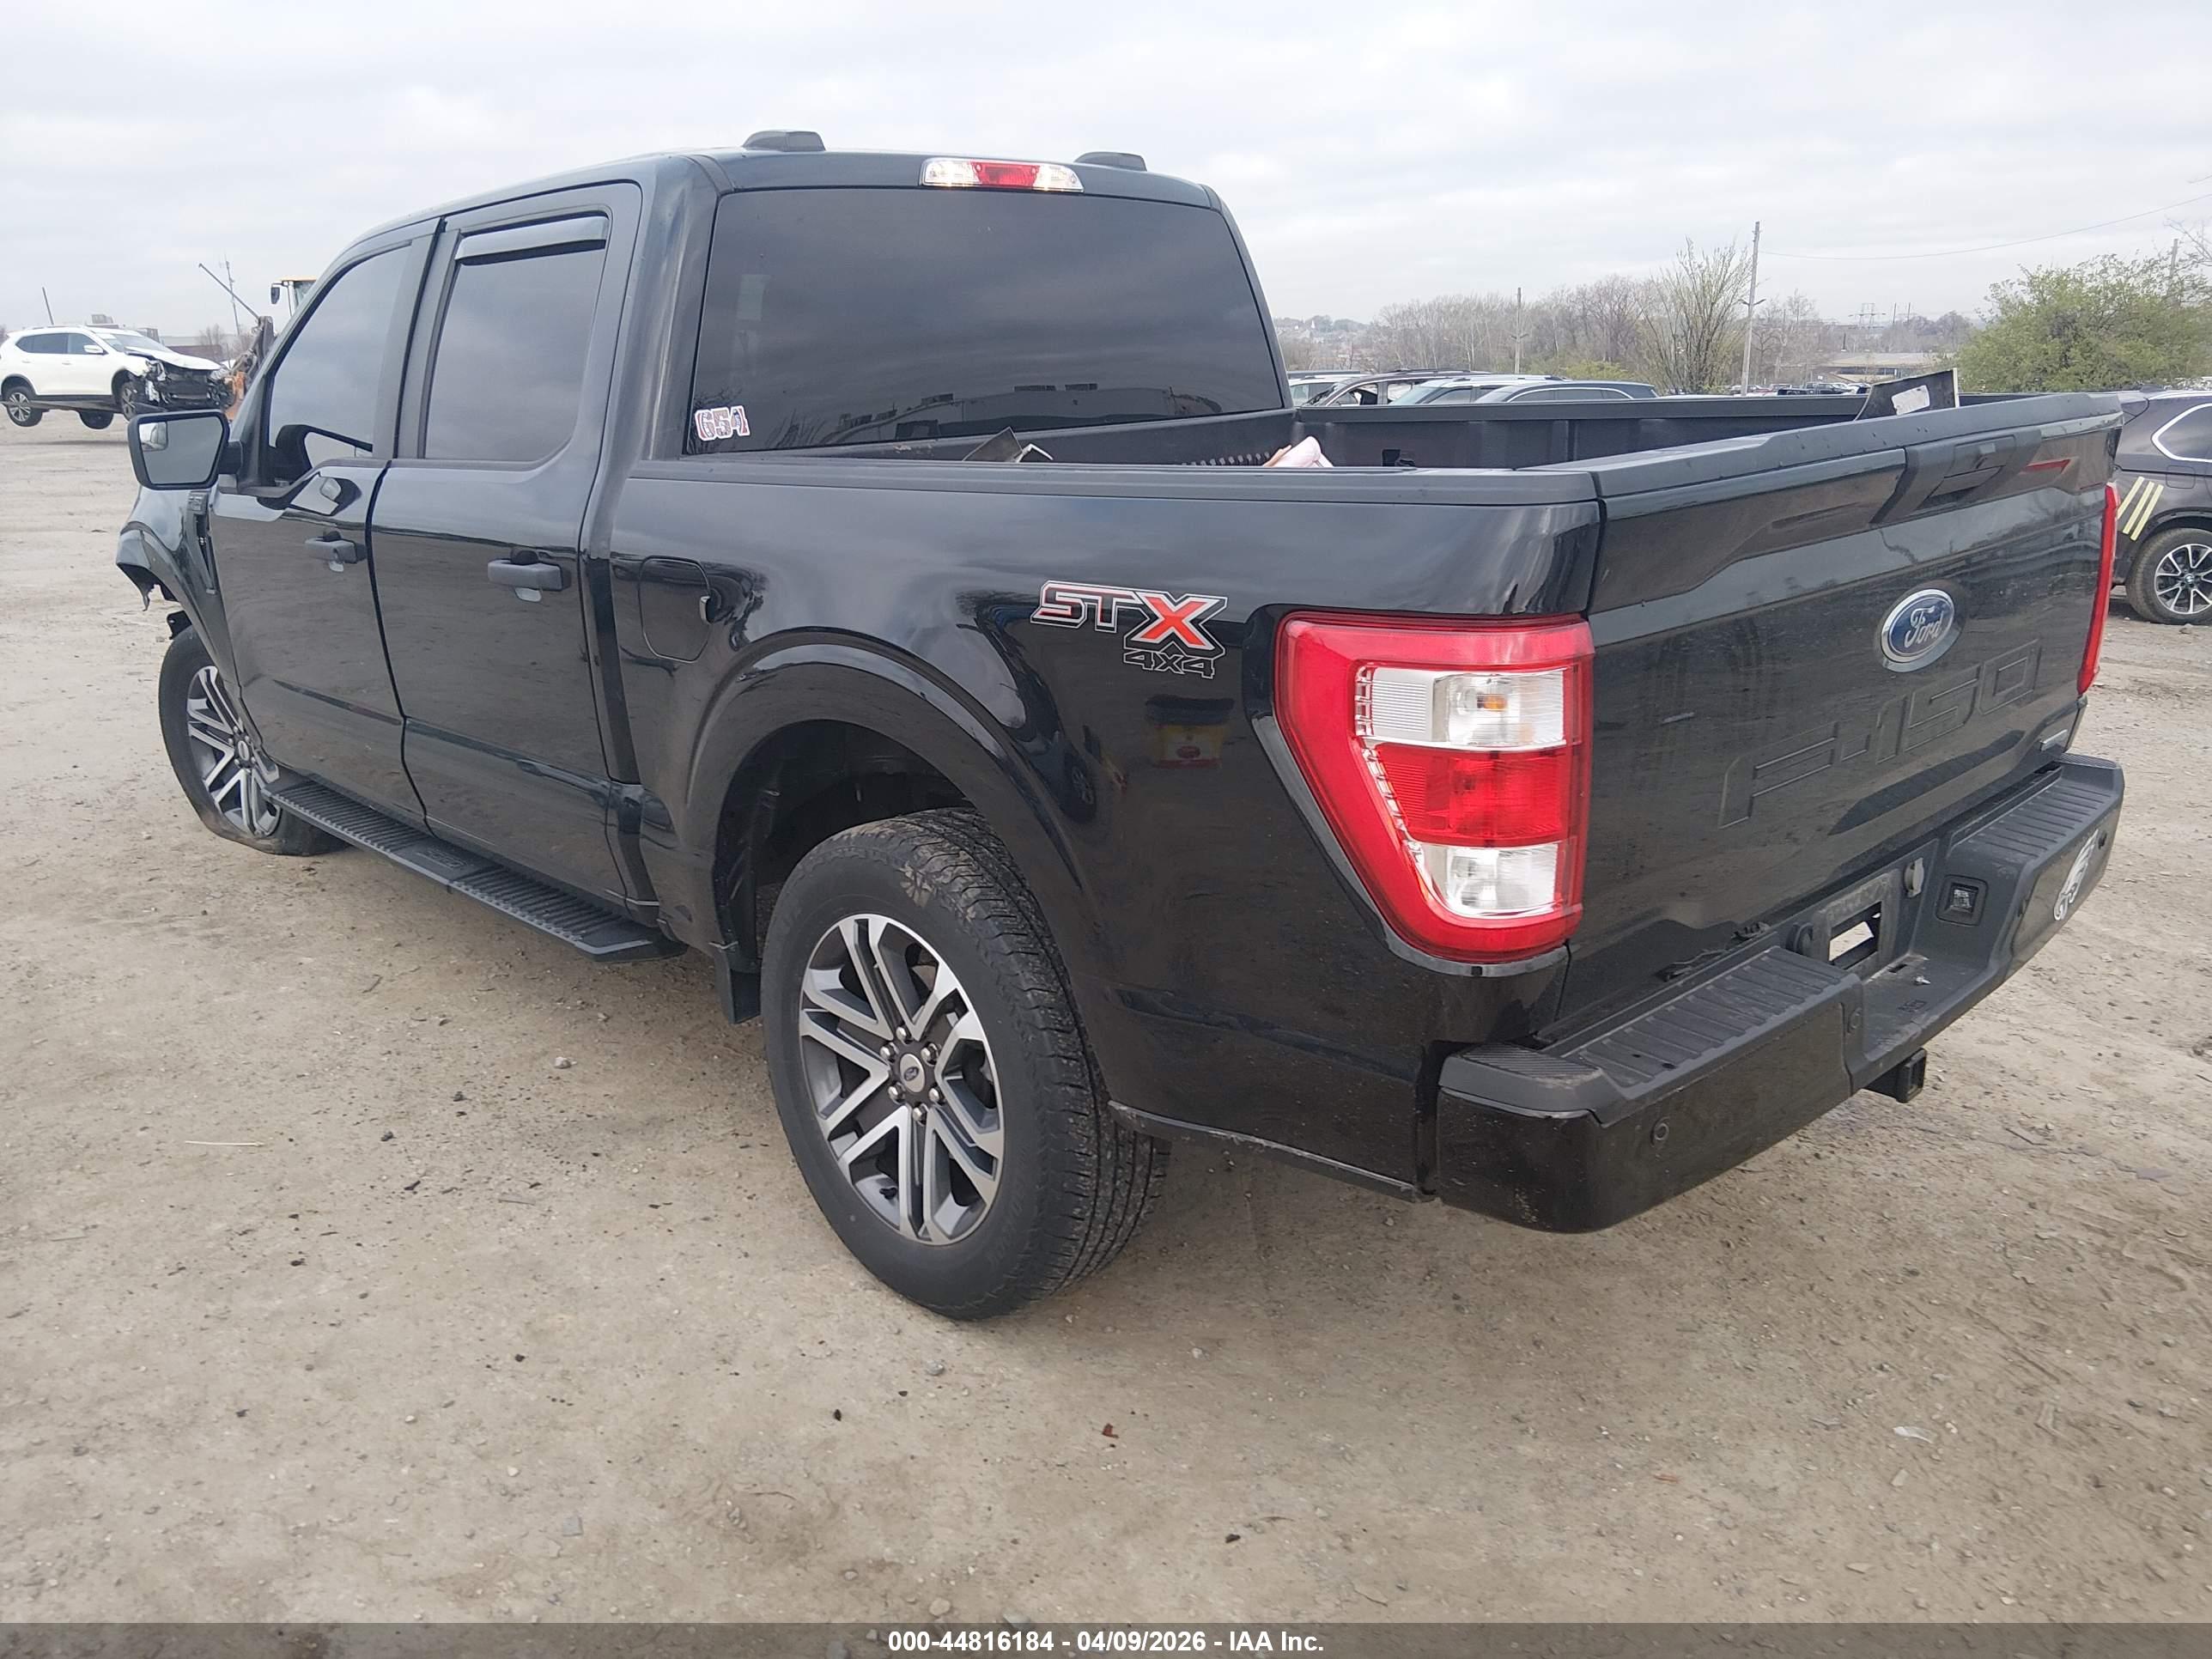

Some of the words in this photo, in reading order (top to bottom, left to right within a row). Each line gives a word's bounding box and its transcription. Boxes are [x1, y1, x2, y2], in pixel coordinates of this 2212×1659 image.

[1030, 580, 1228, 659] STX
[1905, 605, 1944, 647] Ford
[1720, 638, 2041, 830] F-150
